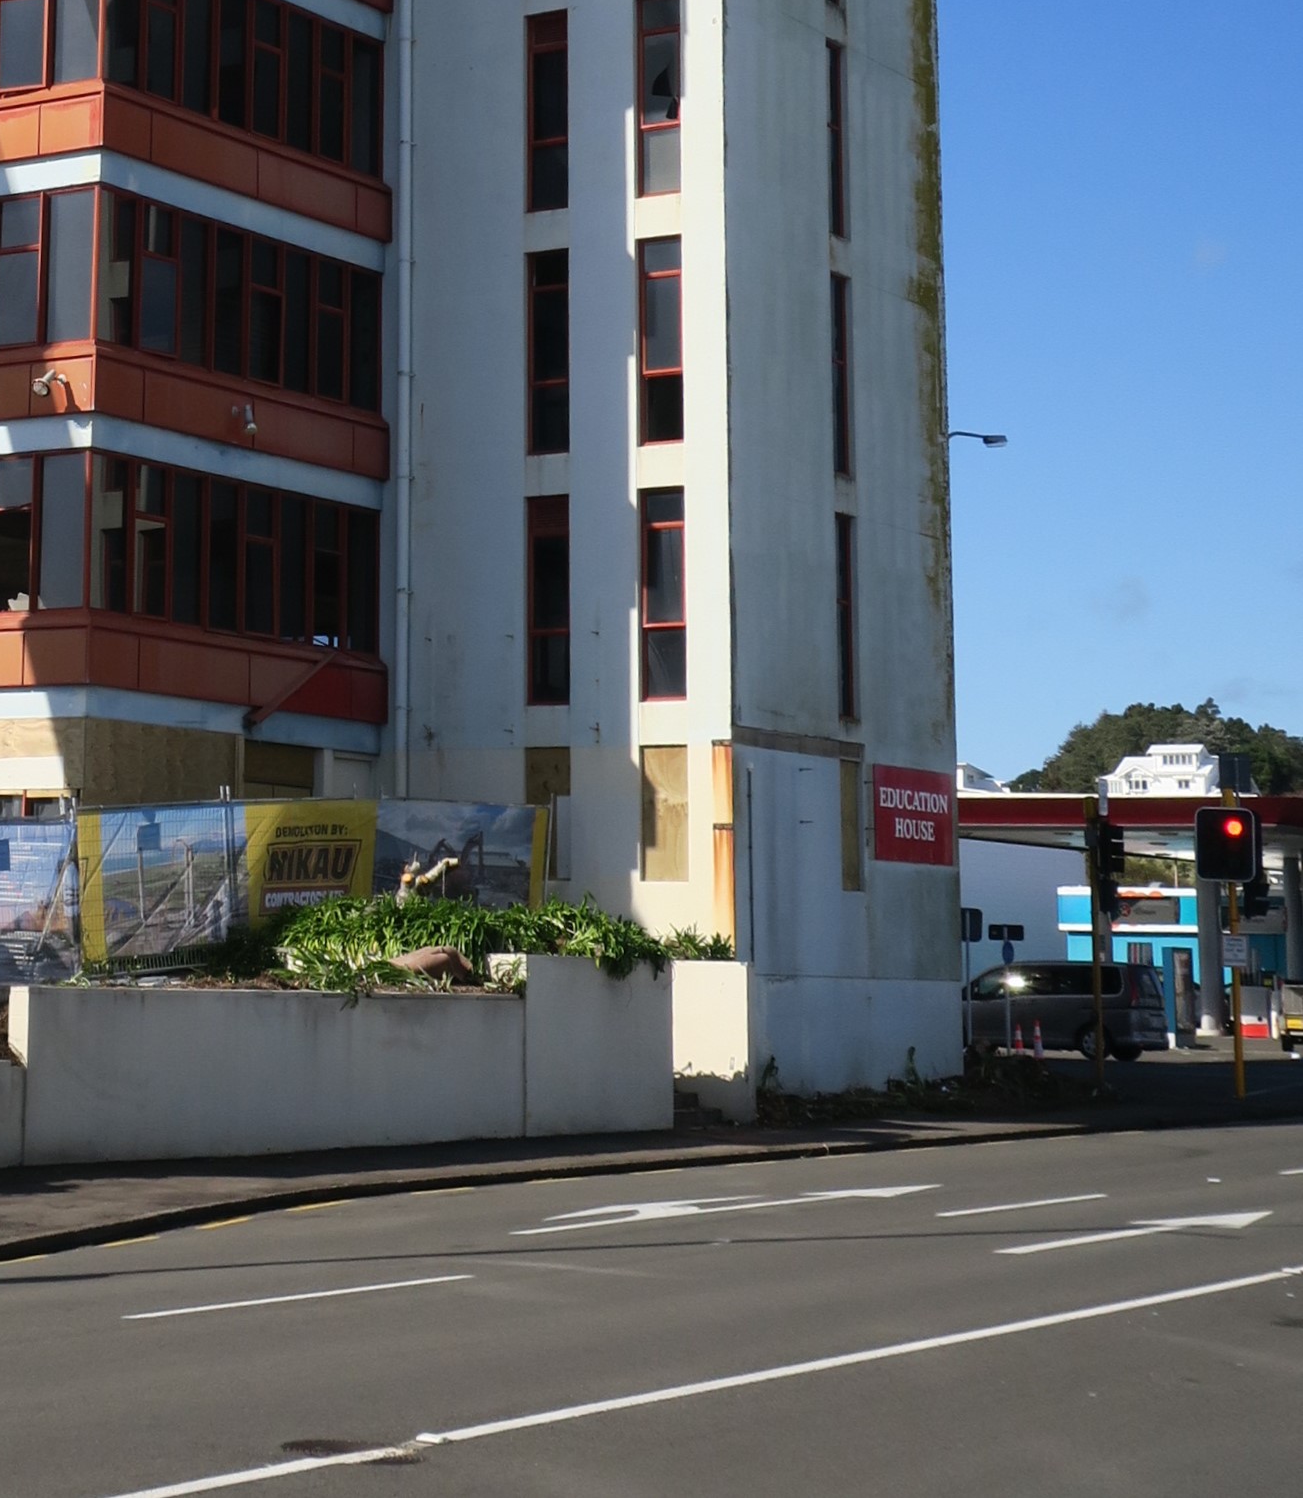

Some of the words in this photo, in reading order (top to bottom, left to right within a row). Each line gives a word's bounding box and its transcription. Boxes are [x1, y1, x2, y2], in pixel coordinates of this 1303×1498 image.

[879, 787, 948, 814] EDUCATION
[275, 824, 329, 838] DEMOLITION
[330, 823, 348, 836] BY:
[895, 817, 936, 841] HOUSE
[268, 847, 354, 882] NIKAU
